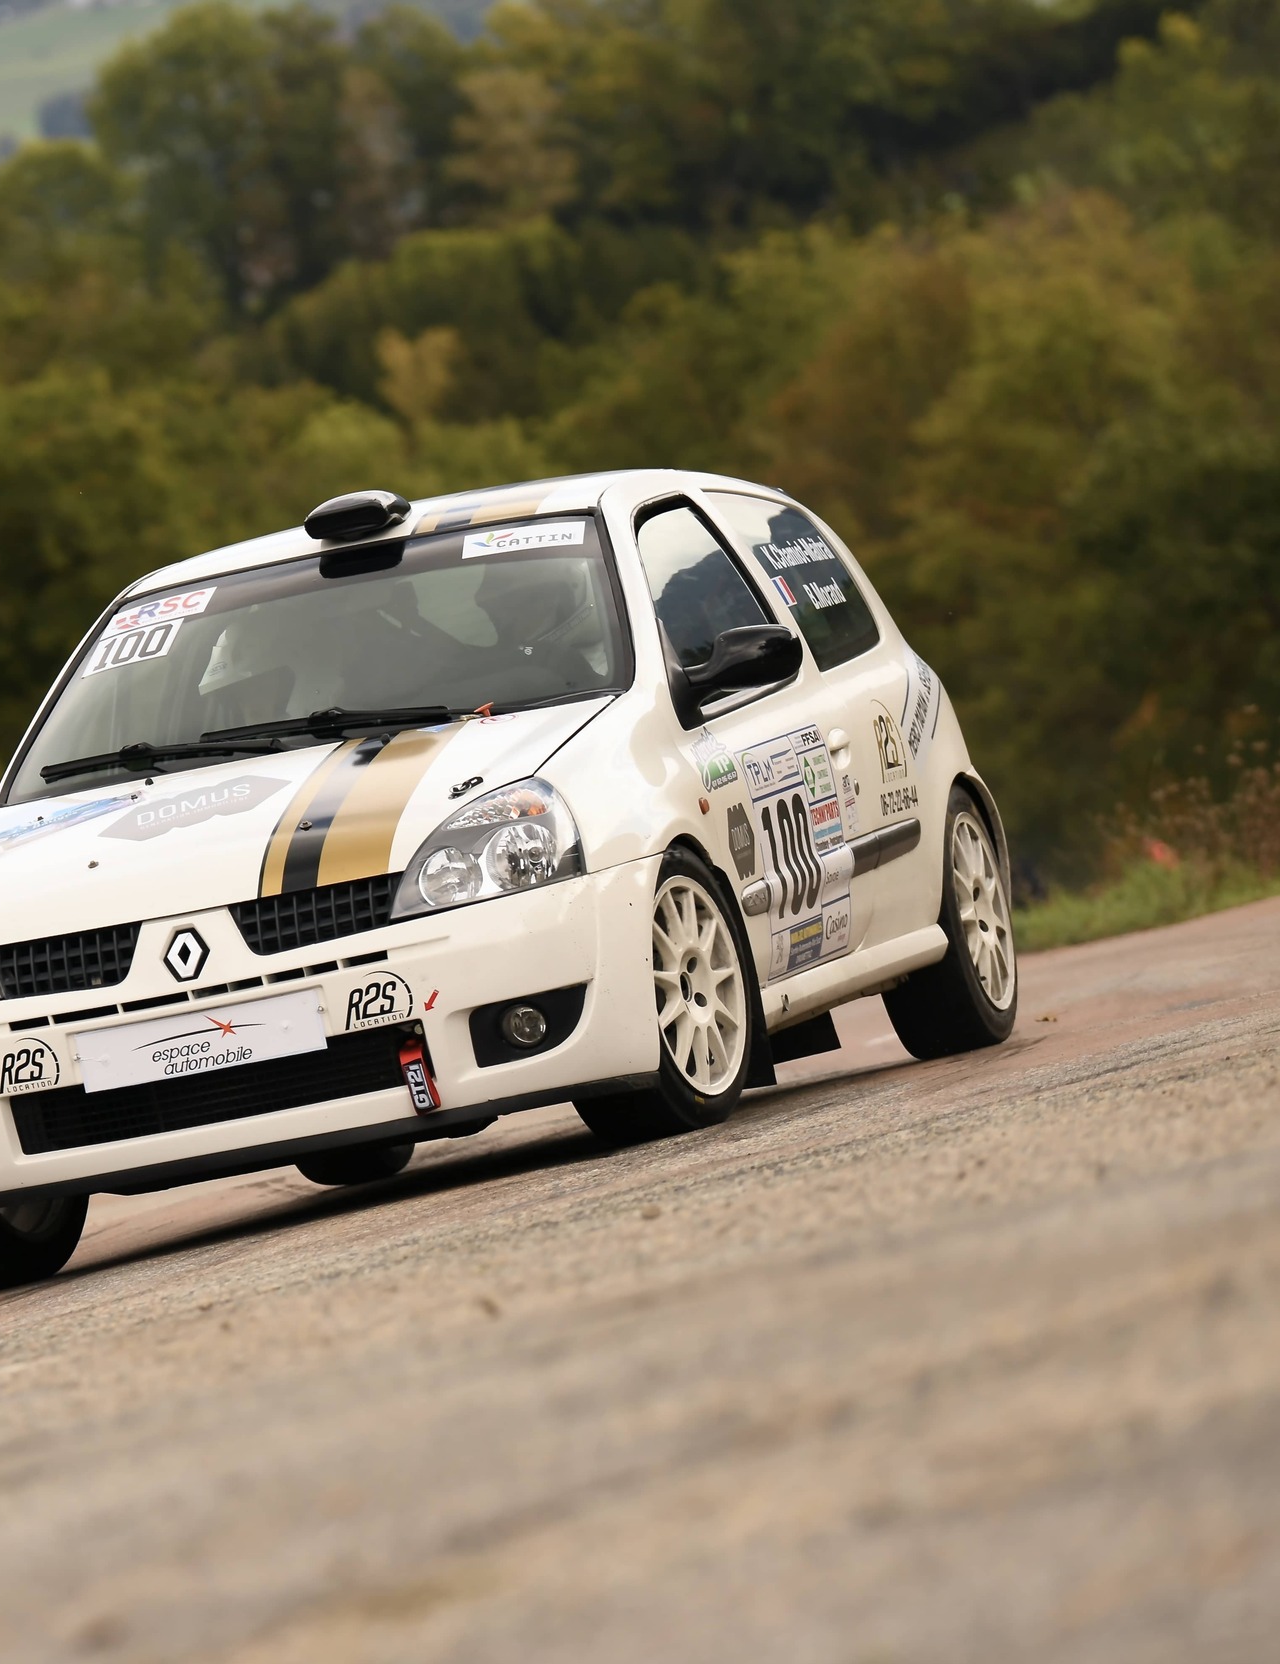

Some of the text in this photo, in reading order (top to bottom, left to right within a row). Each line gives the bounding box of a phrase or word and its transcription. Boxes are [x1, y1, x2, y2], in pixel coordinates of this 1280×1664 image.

[496, 532, 573, 548] CATTIN
[138, 591, 206, 618] RSC
[93, 623, 173, 672] 100
[800, 729, 820, 746] FFSA
[873, 714, 901, 784] R2S
[712, 755, 730, 774] TP
[746, 759, 775, 786] TPLM
[136, 783, 251, 827] DOMUS
[731, 822, 751, 852] DOMUS
[760, 793, 822, 920] 100
[825, 911, 848, 941] Casino
[344, 980, 397, 1031] R2S
[353, 1012, 404, 1029] LOCATION
[152, 1041, 211, 1064] espace
[164, 1046, 253, 1076] automobile
[0, 1047, 46, 1094] R2S
[6, 1079, 53, 1094] LOCATION
